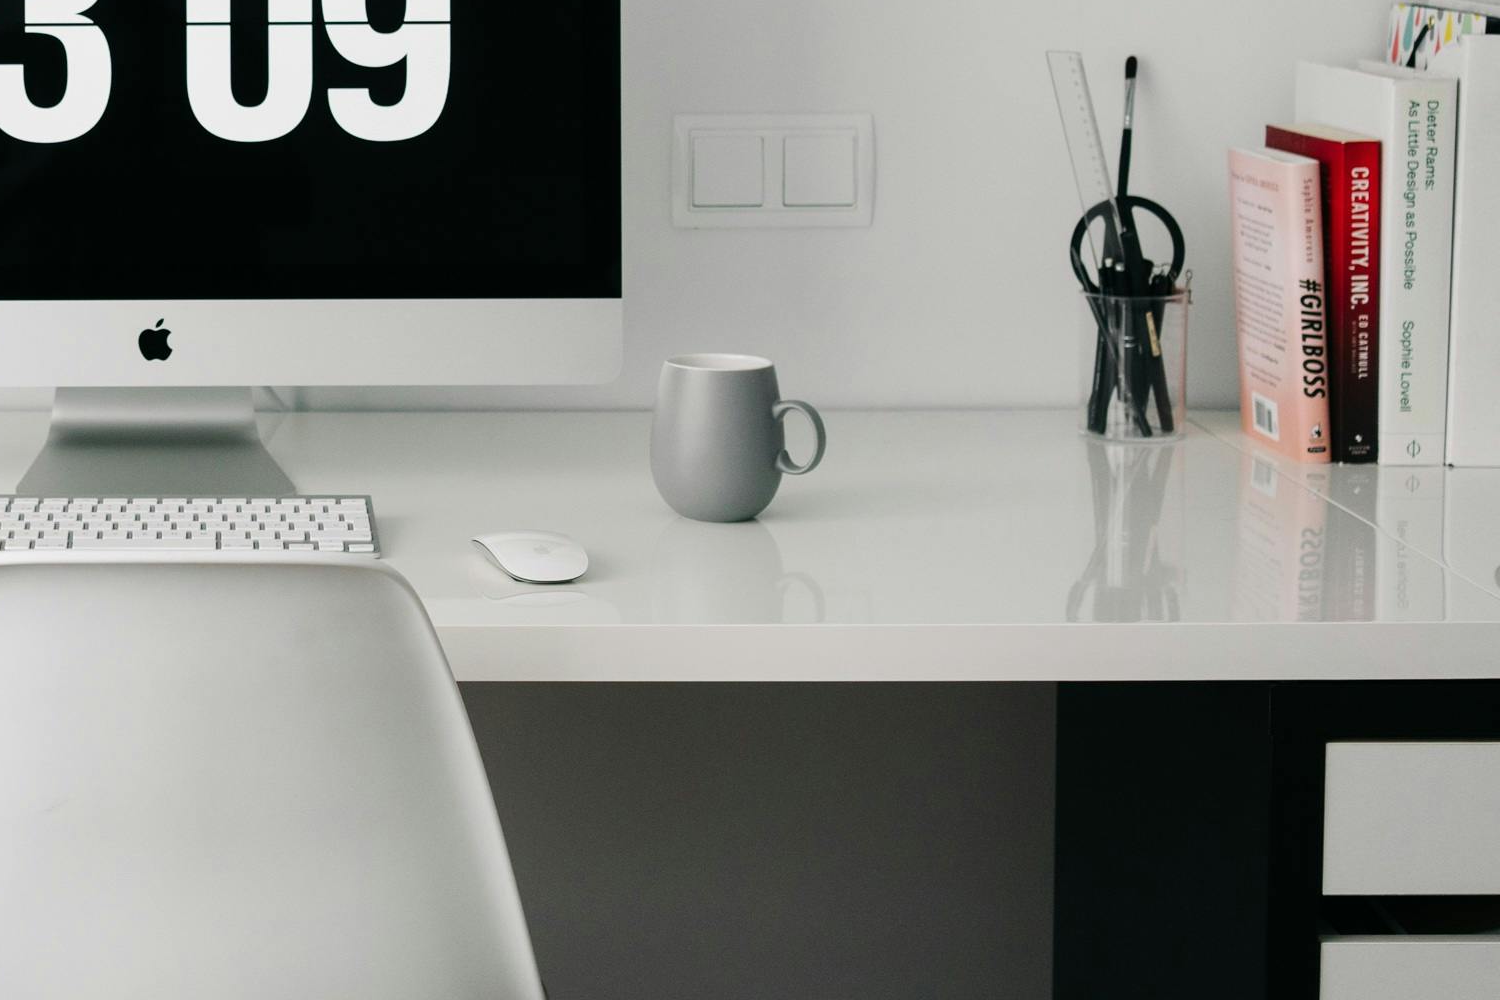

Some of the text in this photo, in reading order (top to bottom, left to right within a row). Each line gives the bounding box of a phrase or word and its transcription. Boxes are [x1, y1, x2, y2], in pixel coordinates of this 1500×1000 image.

[1403, 100, 1420, 290] As Little Design as Possible
[1425, 100, 1440, 190] Dieter Rams:
[1348, 166, 1370, 310] CREATIVITY, INC.
[1299, 278, 1326, 399] #GIRLBOSS
[1357, 314, 1369, 380] ED CATMULL
[1398, 321, 1415, 412] Sophie Lovell
